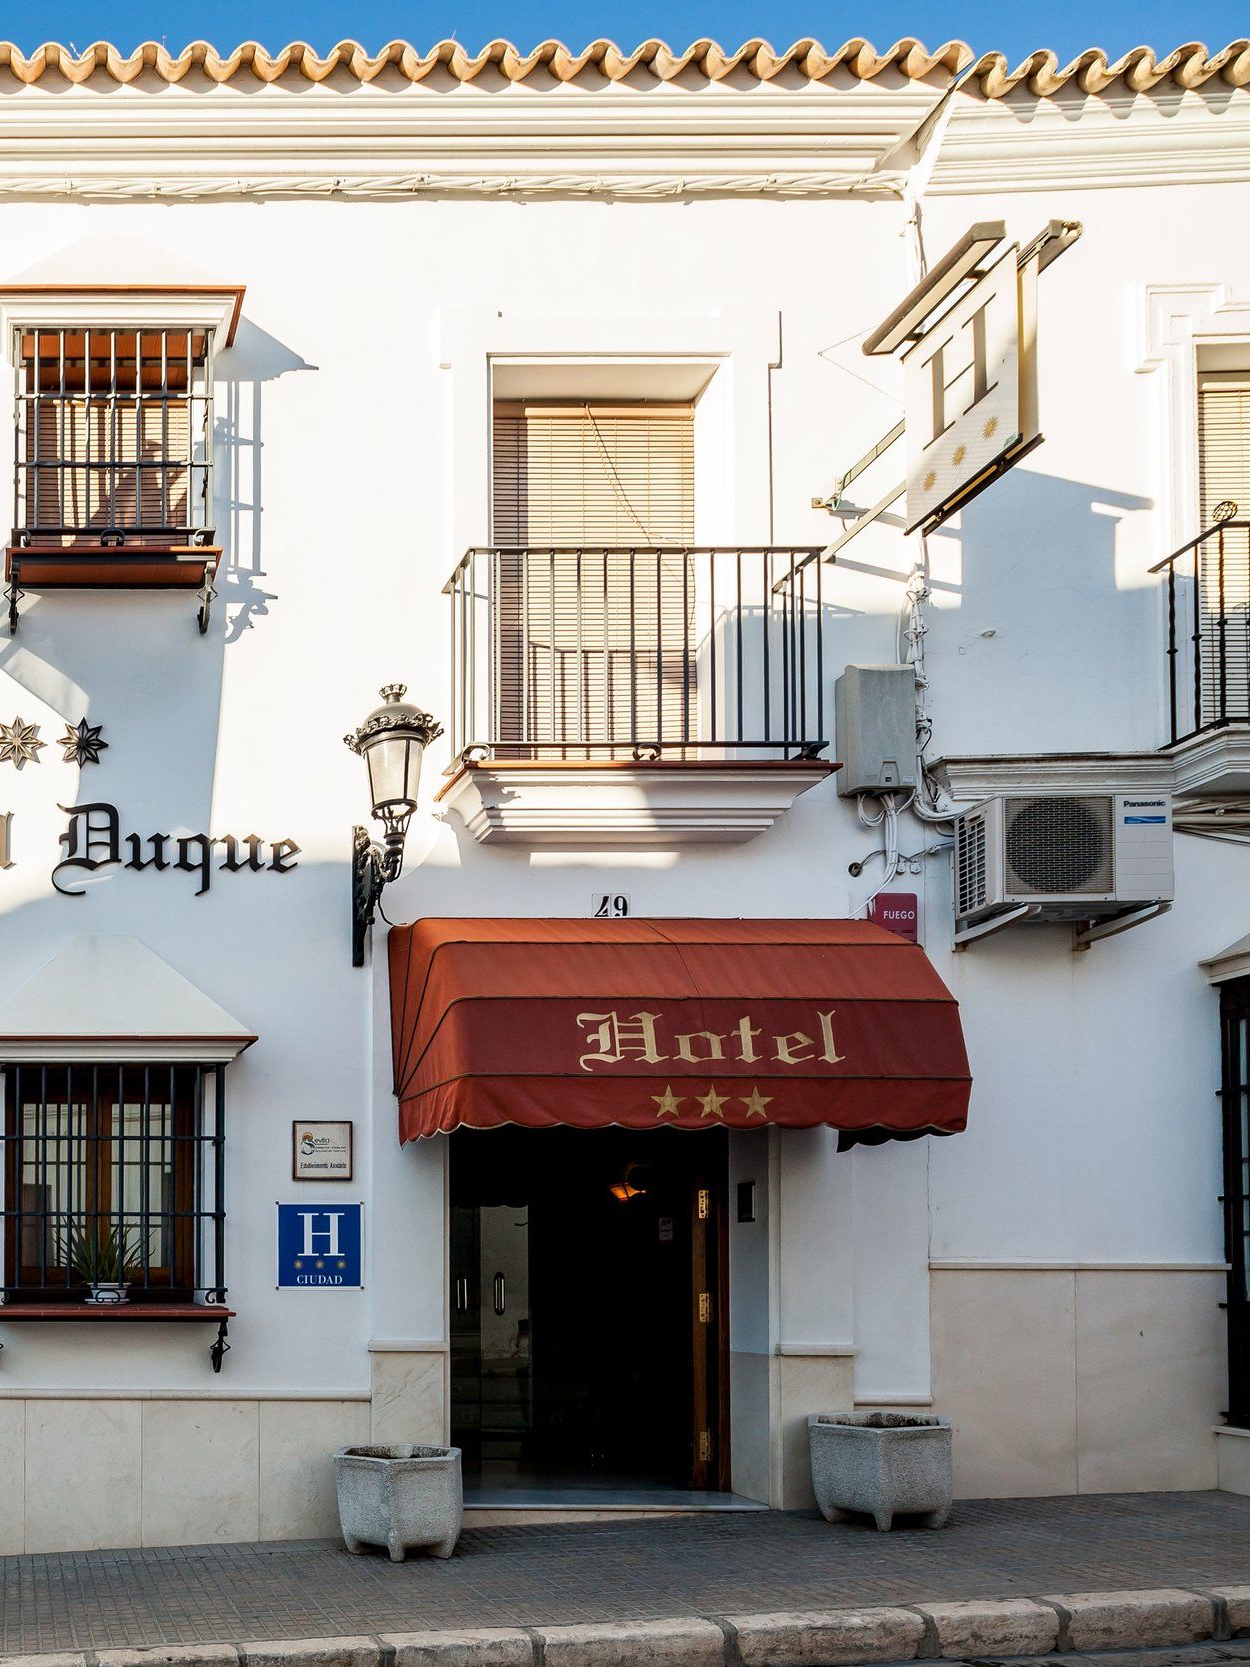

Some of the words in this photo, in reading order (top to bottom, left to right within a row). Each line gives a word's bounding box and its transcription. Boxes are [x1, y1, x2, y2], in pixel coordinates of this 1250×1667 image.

[51, 802, 303, 896] Duque
[594, 895, 628, 917] 49
[883, 910, 915, 920] FUEGO
[576, 1010, 846, 1071] Hotel
[297, 1213, 345, 1256] H
[296, 1274, 343, 1284] CIUDAD
